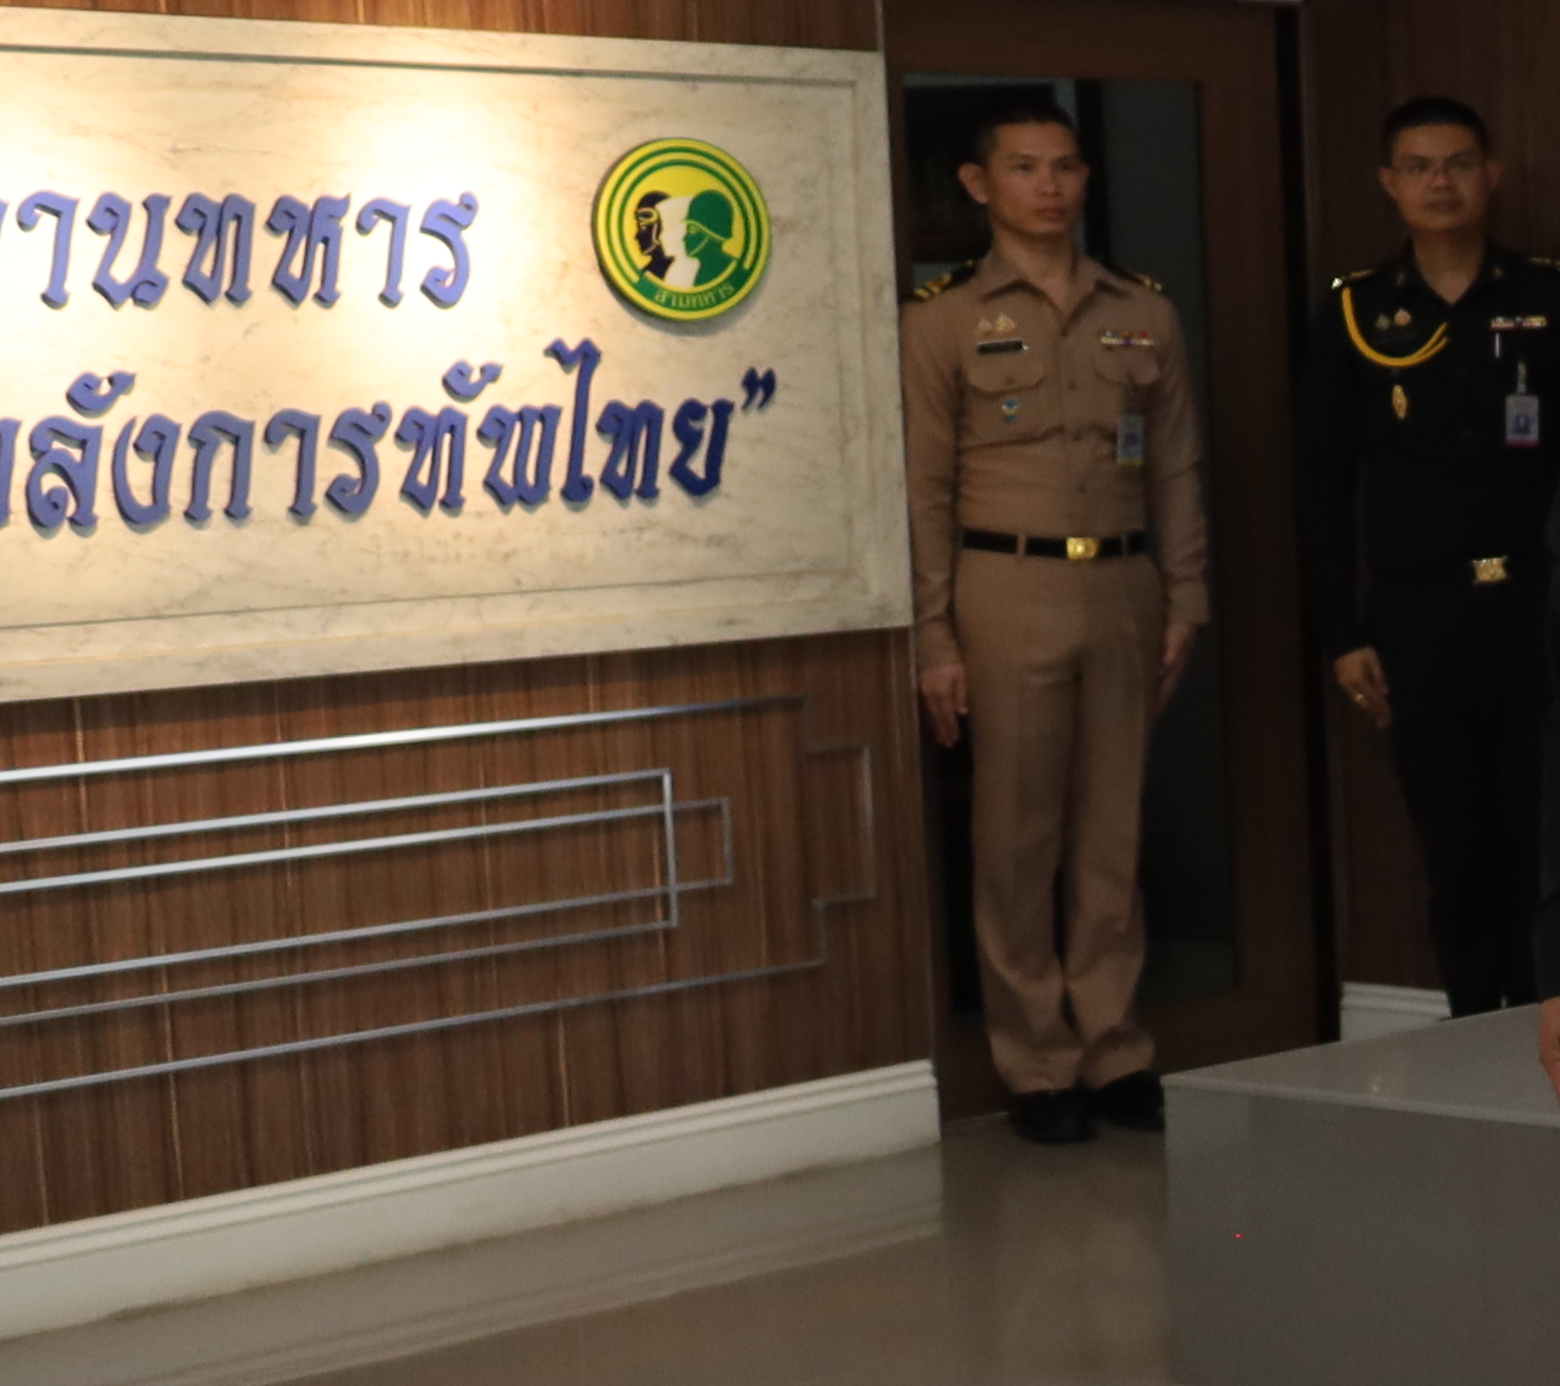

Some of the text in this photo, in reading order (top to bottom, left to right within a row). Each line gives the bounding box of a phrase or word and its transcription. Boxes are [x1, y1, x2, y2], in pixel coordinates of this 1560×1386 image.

[0, 190, 479, 310] านทหาร
[0, 337, 777, 538] ลังการทัพไทย”
